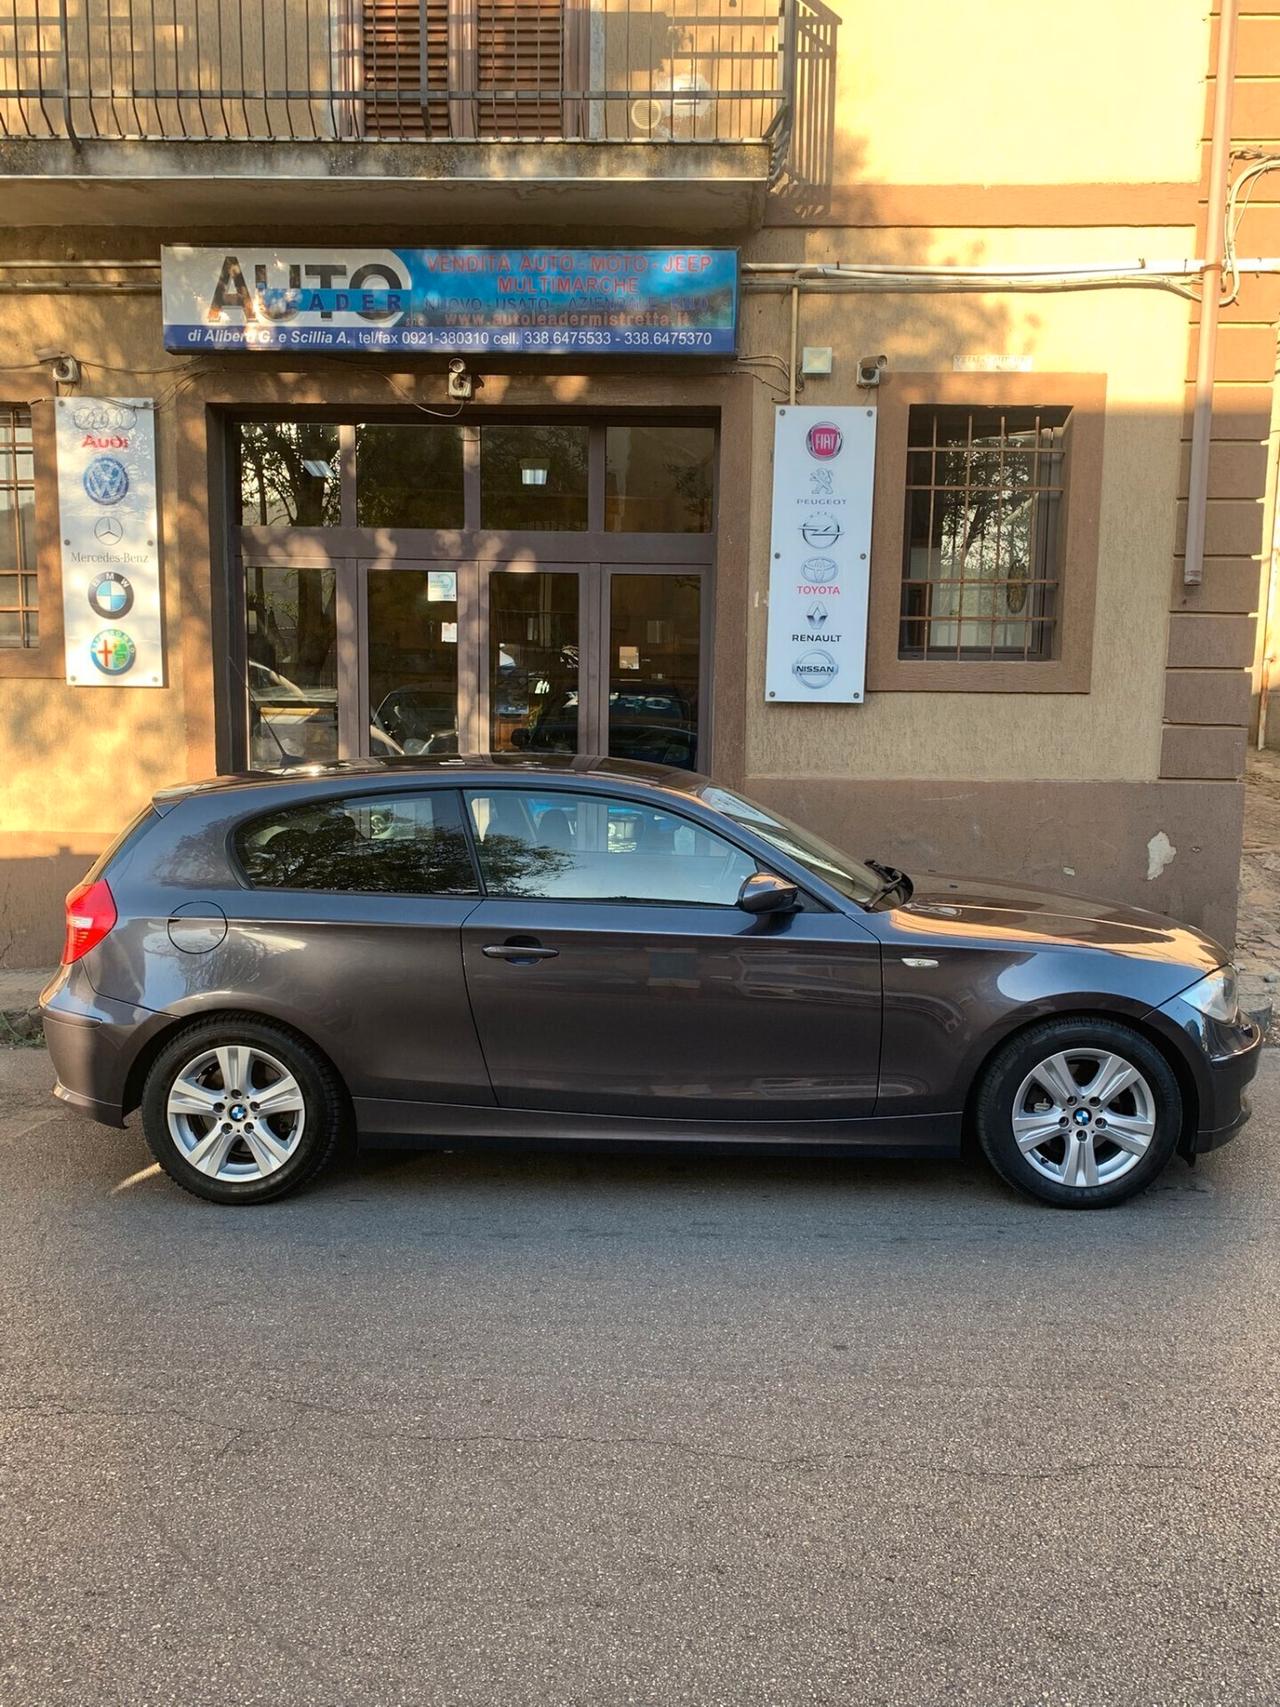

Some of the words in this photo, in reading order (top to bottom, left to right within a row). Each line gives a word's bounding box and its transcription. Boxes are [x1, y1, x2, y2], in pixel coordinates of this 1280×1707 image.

[427, 256, 510, 272] VENDITA
[520, 256, 574, 272] AUTO
[592, 256, 647, 272] MOTO
[663, 255, 713, 272] JEEP
[208, 255, 402, 322] AUTO
[497, 277, 640, 293] MULTIMARCHE
[264, 293, 401, 311] EADER
[425, 297, 482, 311] NUOVO
[496, 297, 550, 311] USATO
[445, 311, 691, 327] www.autoleadermistretta.it
[188, 329, 202, 342] di
[259, 330, 274, 343] G.
[278, 332, 287, 343] e
[291, 330, 333, 344] Scillia
[336, 330, 351, 344] A.
[359, 331, 398, 346] tel/fax
[402, 332, 489, 346] 0921-380310
[493, 331, 519, 346] cell.
[524, 332, 611, 346] 338.6475533
[624, 332, 712, 346] 338.6475370
[815, 432, 835, 449] FIAT
[71, 551, 149, 564] Mercedes-Benz
[91, 572, 130, 588] BMW
[796, 585, 841, 595] TOYOTA
[791, 633, 842, 642] RENAULT
[796, 665, 835, 673] NISSAN
